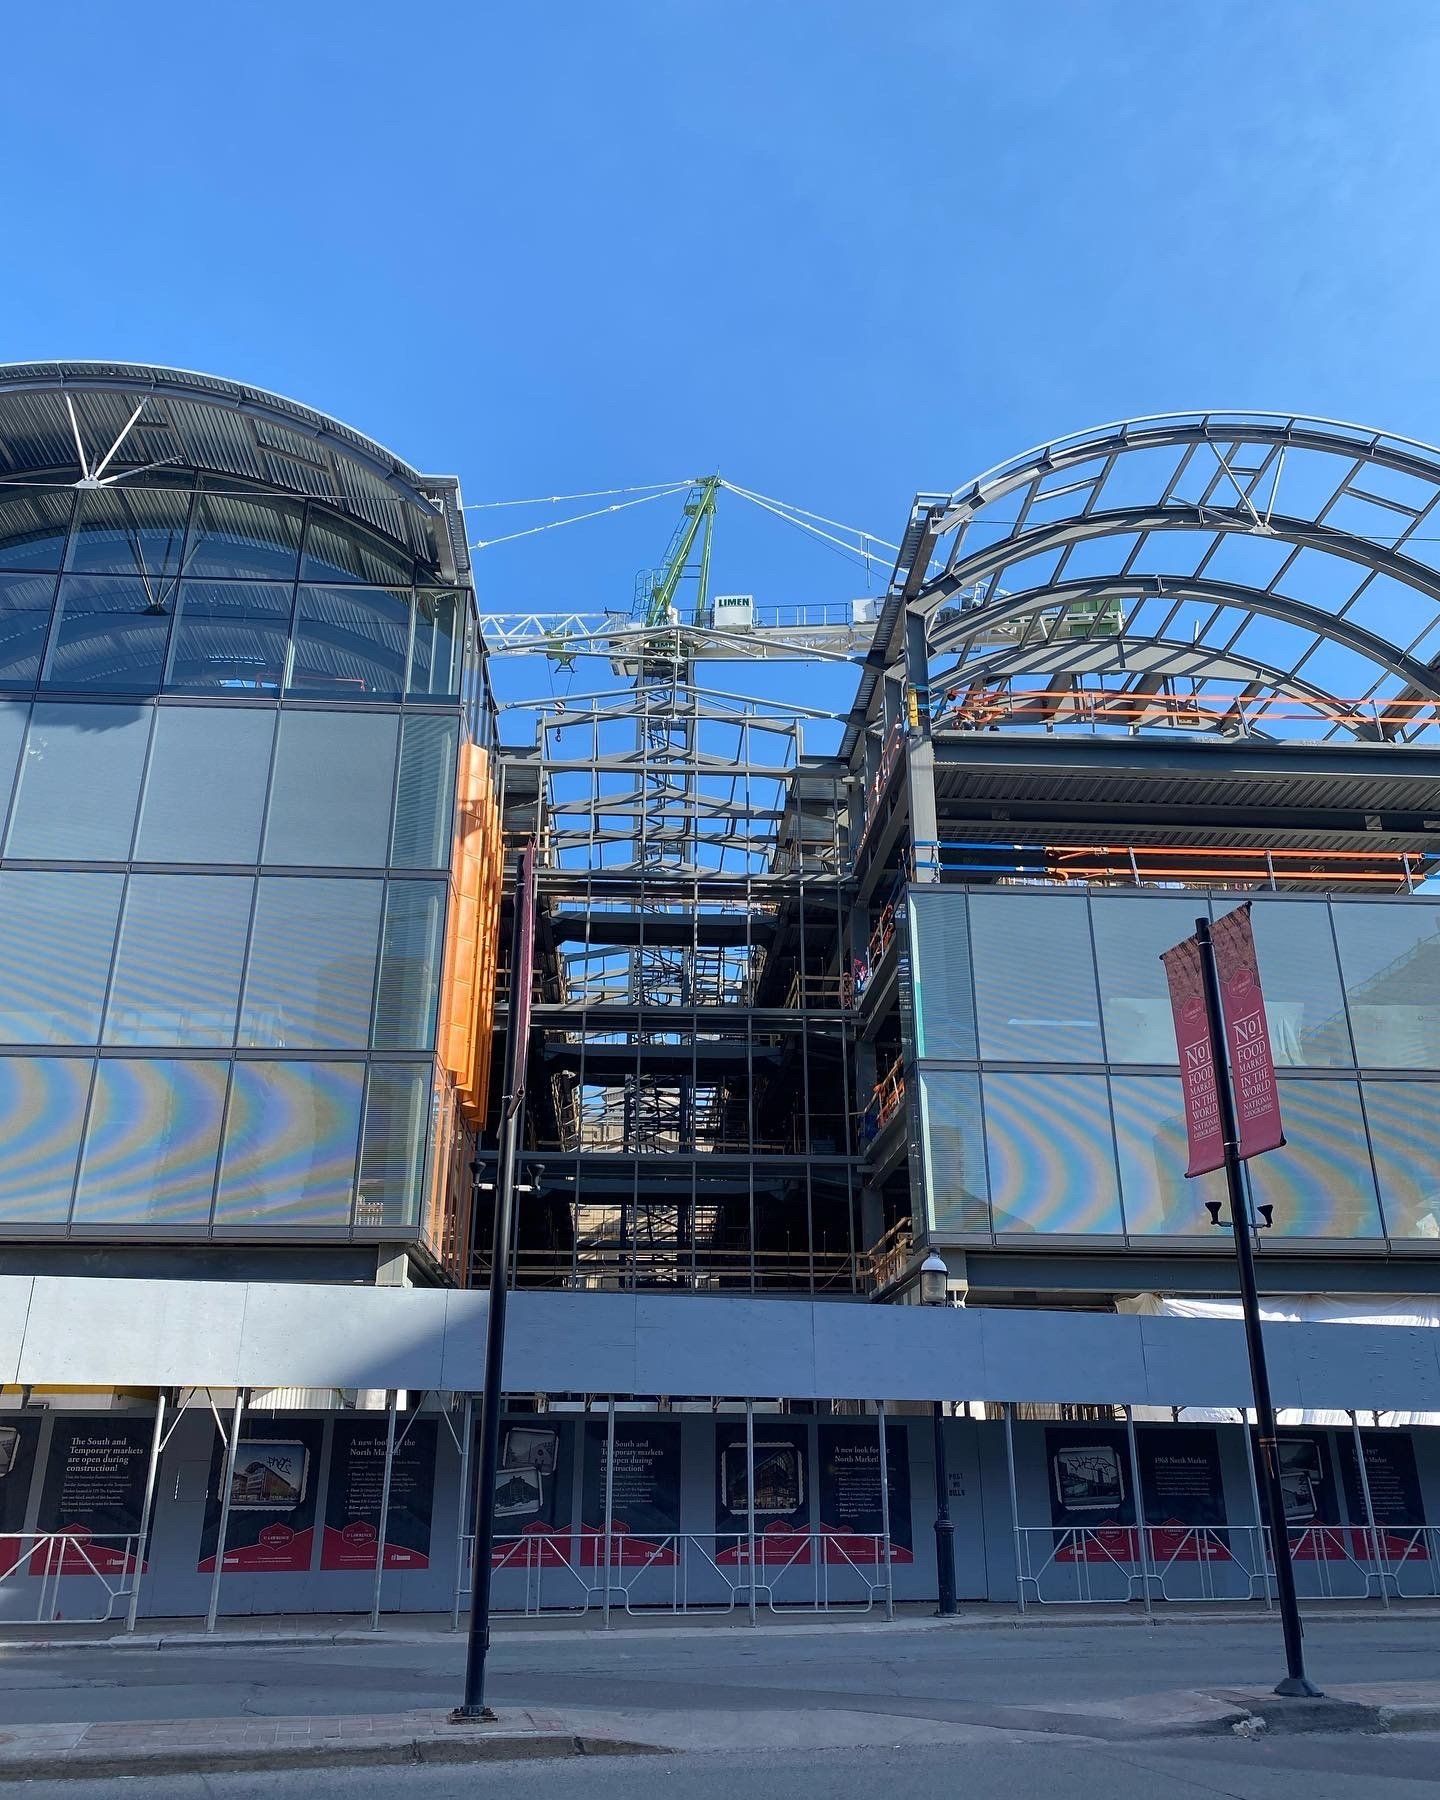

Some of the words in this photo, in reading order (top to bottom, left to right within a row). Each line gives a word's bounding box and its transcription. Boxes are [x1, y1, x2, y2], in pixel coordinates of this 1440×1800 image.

[718, 598, 749, 607] LIMEN
[1237, 1040, 1266, 1063] FOOD
[1239, 1054, 1267, 1073] MARKET
[1189, 1065, 1214, 1086] FOOD
[1240, 1075, 1251, 1089] IN
[1252, 1066, 1270, 1084] THE
[1242, 1079, 1271, 1098] WORLD
[1191, 1098, 1201, 1111] IN
[1202, 1090, 1217, 1106] THE
[1243, 1094, 1272, 1111] NATIONAL
[1192, 1102, 1218, 1120] WORLD
[71, 1437, 86, 1445] The
[87, 1437, 110, 1445] South
[111, 1437, 127, 1445] and
[69, 1446, 112, 1456] Temporary
[112, 1446, 144, 1454] markets
[350, 1448, 372, 1456] North
[601, 1448, 637, 1457] Teporary
[637, 1448, 664, 1456] markets
[81, 1457, 101, 1465] open
[102, 1454, 129, 1465] during
[630, 1455, 653, 1465] during
[1169, 1456, 1187, 1464] North
[1187, 1456, 1208, 1464] Market
[66, 1464, 118, 1472] construction!
